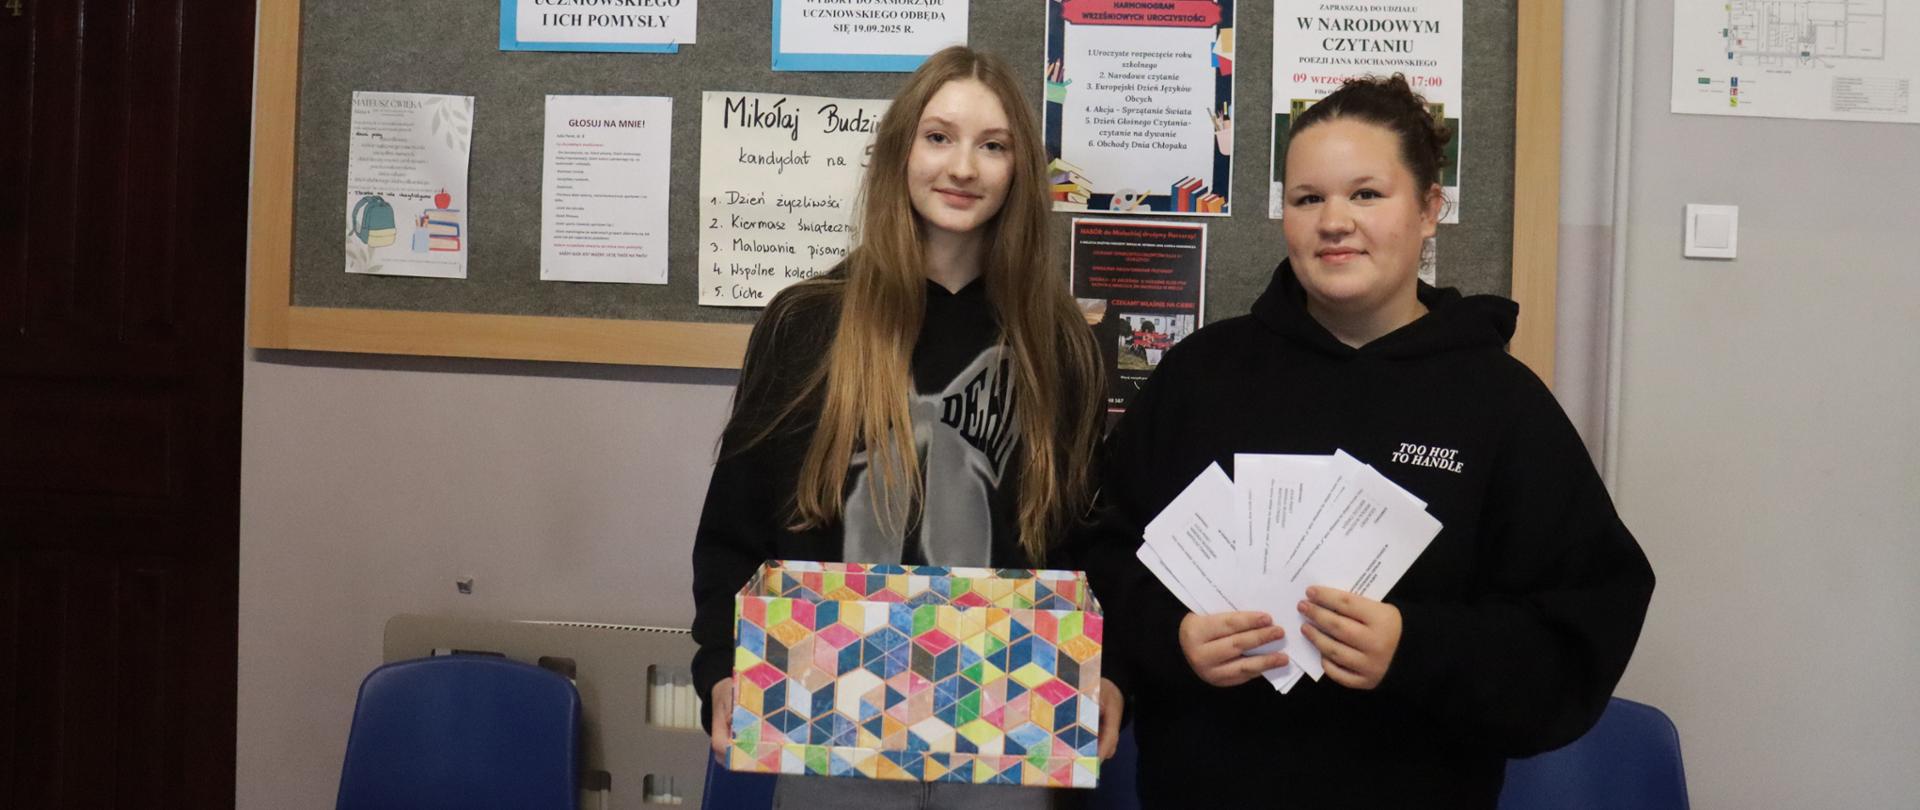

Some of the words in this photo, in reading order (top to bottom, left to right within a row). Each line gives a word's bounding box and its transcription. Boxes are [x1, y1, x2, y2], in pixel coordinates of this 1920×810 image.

[1114, 1, 1175, 10] HARMONOGRAM
[1320, 3, 1369, 13] ZAPRASZAJĄ
[542, 13, 548, 26] I
[553, 13, 582, 26] ICH
[803, 8, 897, 19] UCZNIOWSKIEGO
[900, 10, 946, 21] ODBĘDĄ
[1082, 11, 1144, 21] WRZEŚNIOWYCH
[1147, 12, 1206, 23] UROCZYSTOŚCI
[833, 24, 850, 34] SIĘ
[854, 24, 901, 33] 19.09.2025
[904, 25, 914, 33] R.
[1297, 17, 1313, 30] W
[1318, 17, 1441, 34] NARODOWYM
[1322, 38, 1414, 53] CZYTANIU
[1131, 50, 1173, 61] rozpoczęcie
[1175, 50, 1192, 59] roku
[1299, 56, 1329, 65] POEZJI
[1330, 57, 1352, 66] JANA
[1354, 57, 1438, 67] KOCHANOWSKIEGO
[1122, 60, 1158, 71] szkolnego
[1107, 72, 1146, 81] Narodowe
[1147, 73, 1180, 83] czytanie
[1293, 73, 1307, 83] 09
[1411, 76, 1443, 87] 17:00
[1095, 83, 1135, 94] Europejski
[1137, 83, 1159, 92] Dzień
[1160, 84, 1192, 95] Języków
[1125, 95, 1153, 105] Obcych
[1093, 105, 1115, 115] Akcja
[1122, 106, 1163, 117] Sprzątanie
[1165, 105, 1192, 115] Świata
[568, 119, 602, 128] GŁOSUJ
[604, 119, 617, 128] NA
[619, 120, 646, 128] MNIE!
[723, 96, 801, 141] Mikołaj
[1093, 116, 1116, 125] Dzień
[1099, 130, 1131, 139] czytanie
[1144, 129, 1177, 139] dywanie
[1096, 140, 1129, 150] Obchody
[1131, 140, 1150, 149] Dnia
[1152, 140, 1188, 152] Chłopaka
[739, 146, 812, 174] kandydat
[827, 156, 847, 167] na
[725, 190, 766, 206] Dzień
[776, 195, 843, 213] życzliwości
[709, 218, 723, 230] 2.
[731, 213, 787, 231] Kiermasz
[710, 241, 723, 252] 3.
[732, 238, 796, 255] Malowanie
[730, 263, 776, 281] Wspólne
[714, 286, 724, 298] 5.
[731, 284, 764, 300] Ciche
[1399, 442, 1427, 456] TOO
[1429, 447, 1459, 460] HOT
[1392, 452, 1410, 464] TO
[1411, 455, 1464, 473] HANDLE
